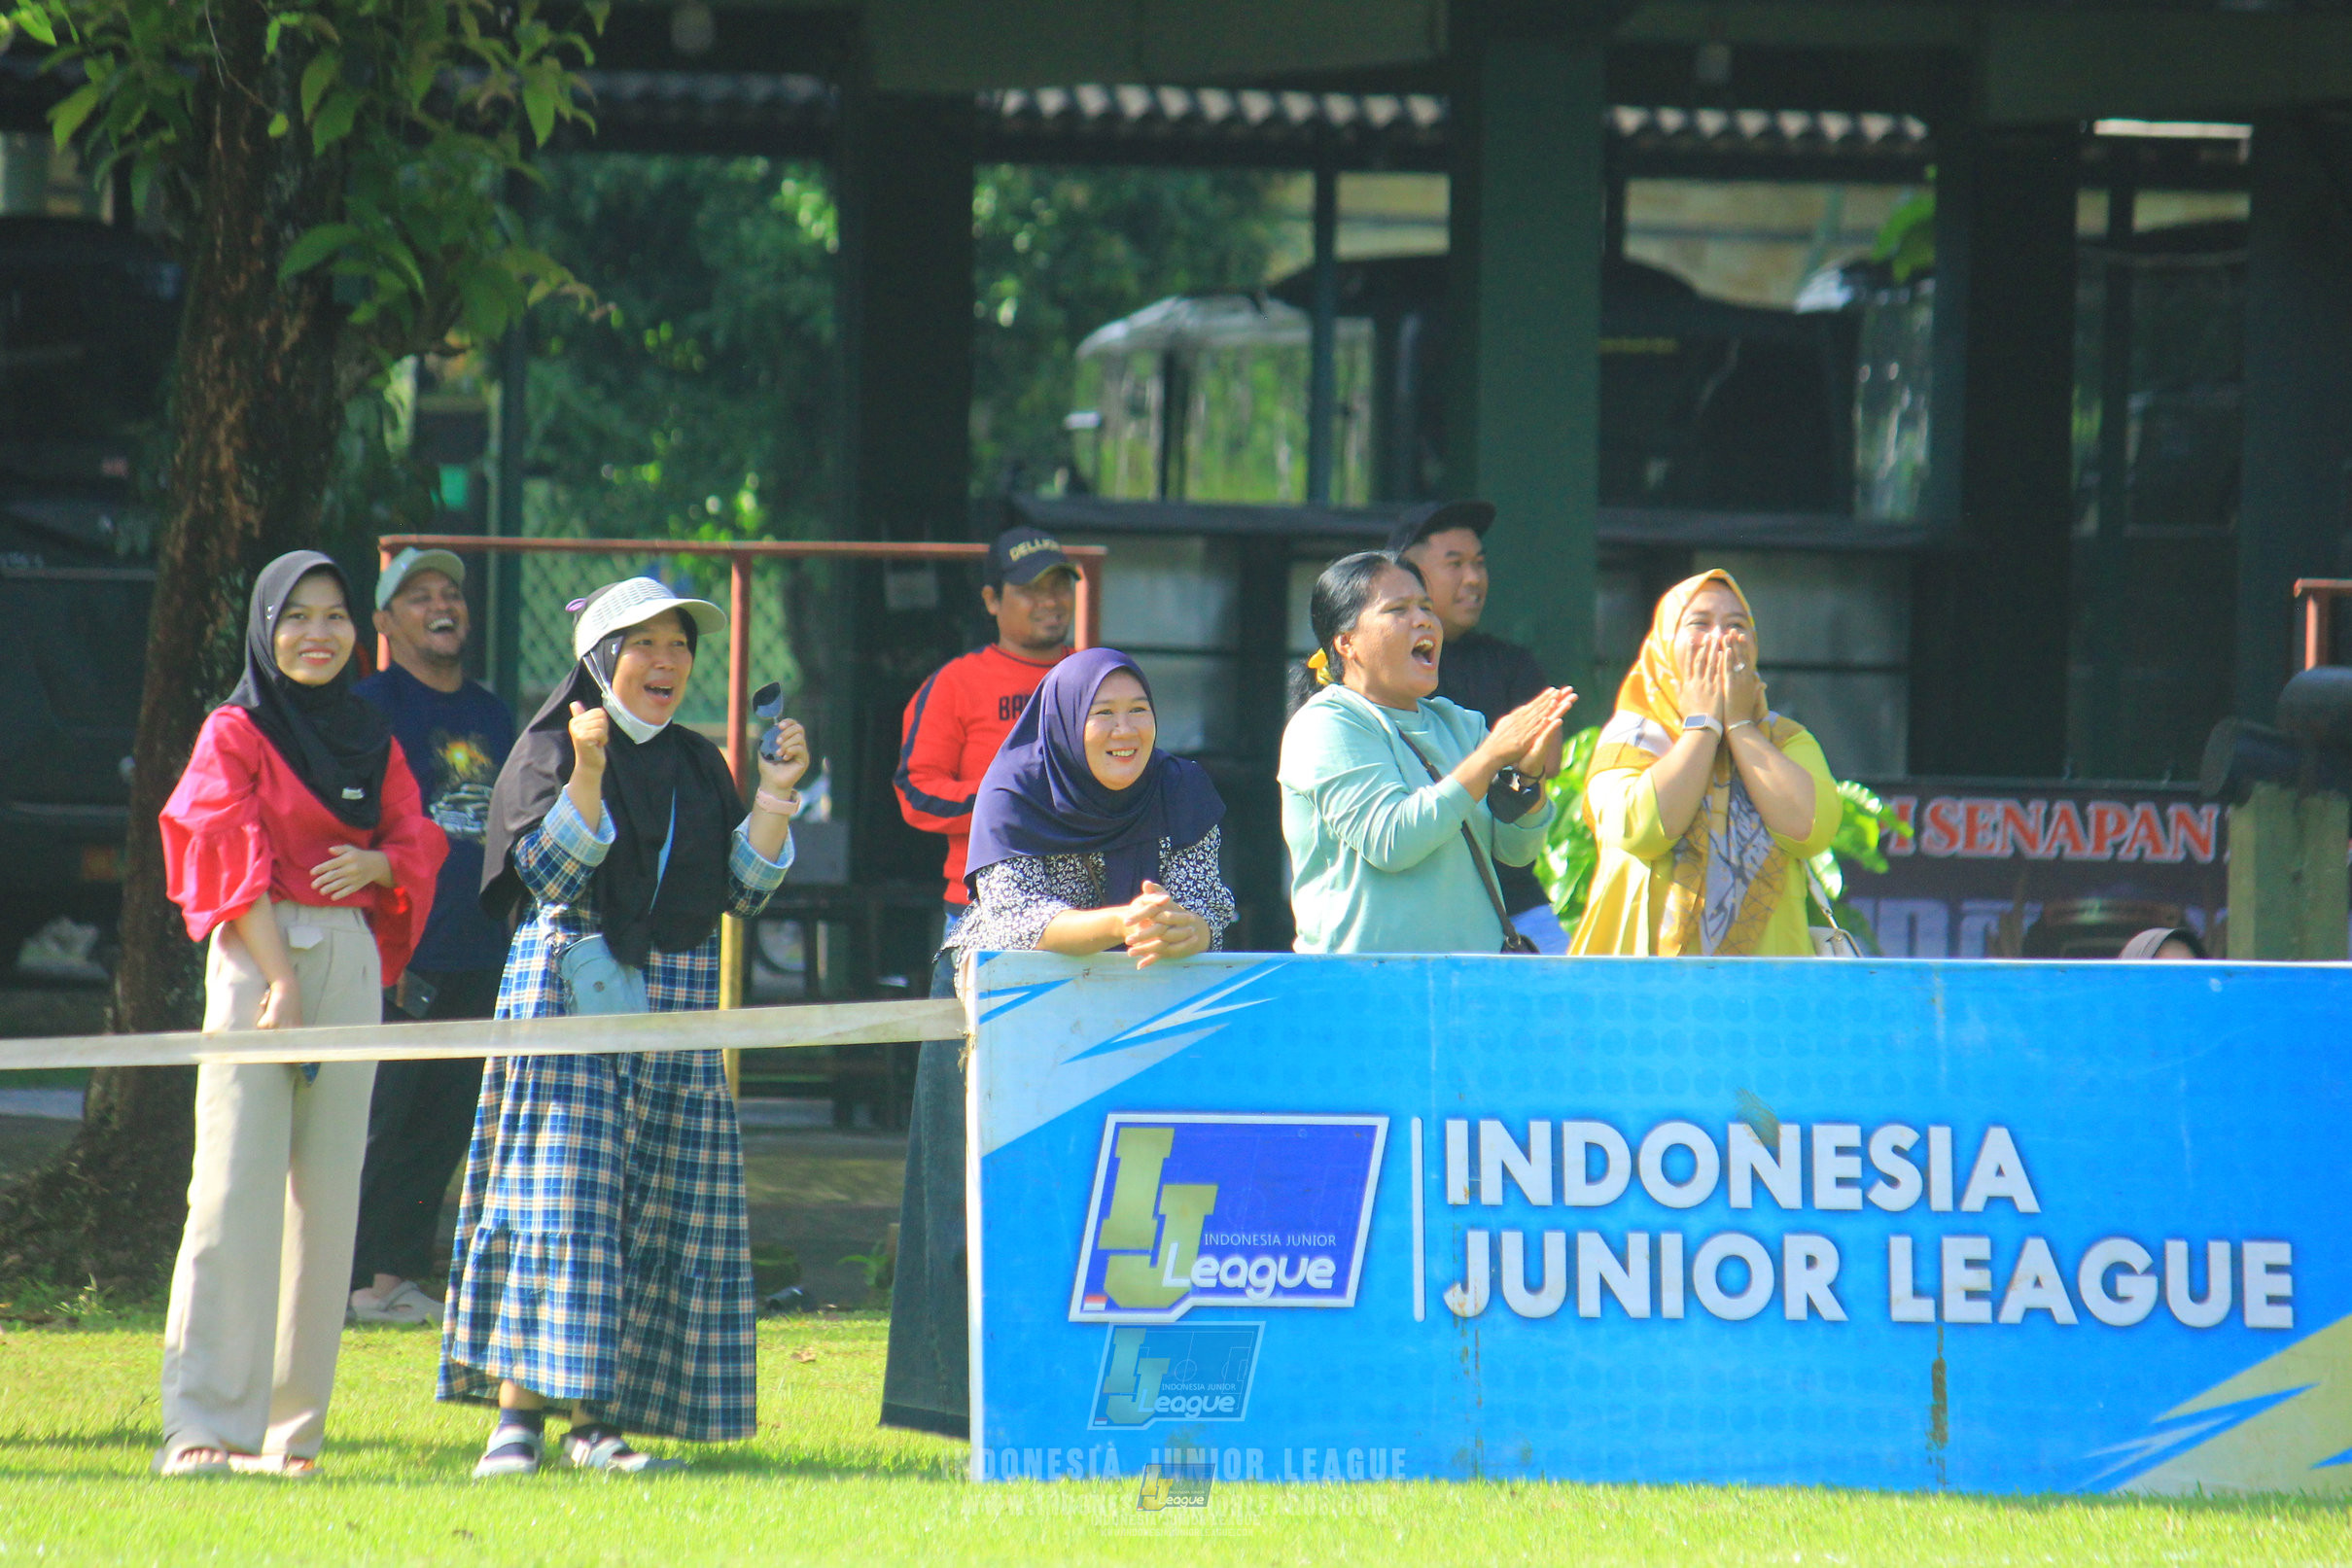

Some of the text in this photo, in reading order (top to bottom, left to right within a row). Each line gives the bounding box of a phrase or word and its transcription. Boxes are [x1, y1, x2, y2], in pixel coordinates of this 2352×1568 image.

[1921, 796, 2220, 864] SENAPAN
[1446, 1119, 2042, 1213] INDONESIA
[1162, 1241, 1337, 1303] League
[1204, 1233, 1337, 1247] INDONESIA JUNIOR
[1443, 1231, 2294, 1329] JUNIOR LEAGUE
